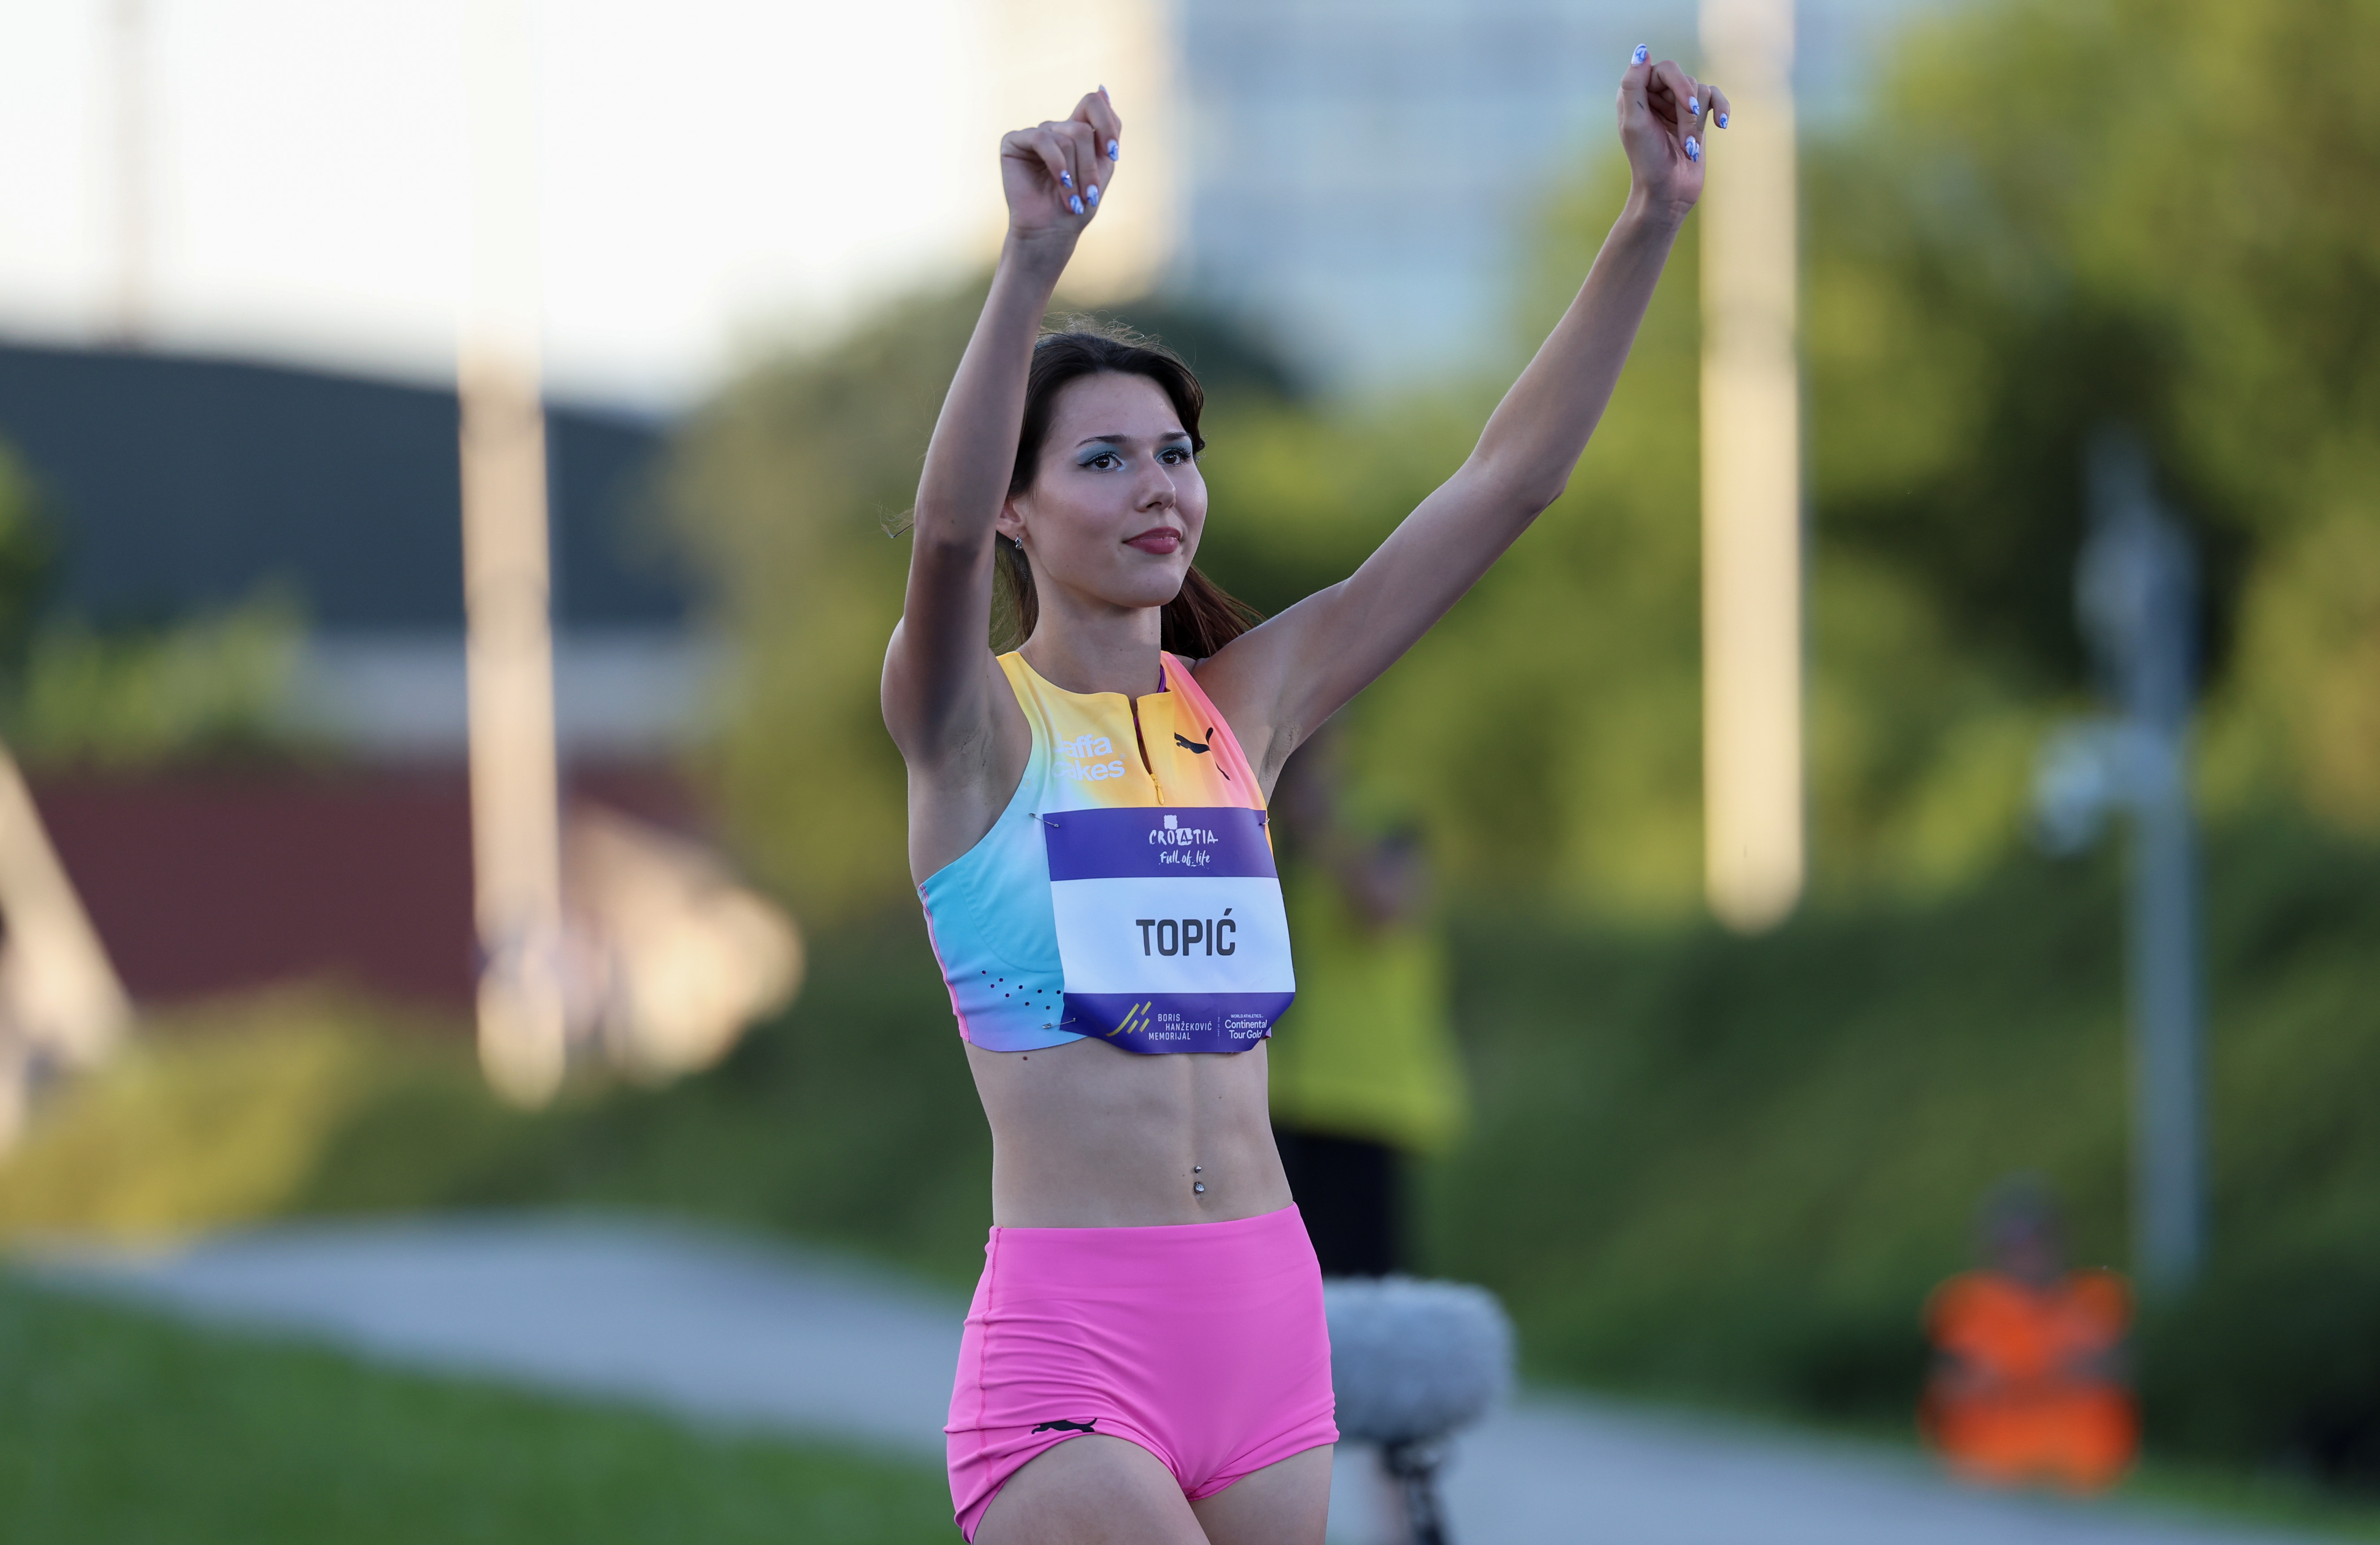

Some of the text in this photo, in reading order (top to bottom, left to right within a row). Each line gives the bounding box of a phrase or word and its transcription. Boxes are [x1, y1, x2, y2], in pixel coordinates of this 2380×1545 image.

[1054, 733, 1113, 758] Jaffa
[1149, 828, 1218, 846] CROATIA
[1160, 850, 1210, 866] Full of life
[1136, 908, 1236, 956] TOPIĆ
[1166, 1021, 1212, 1031] HANŽEKOVIĆ
[1225, 1019, 1267, 1029] Continental
[1149, 1032, 1191, 1040] MEMORIJAL
[1229, 1030, 1262, 1039] Tour Gold
